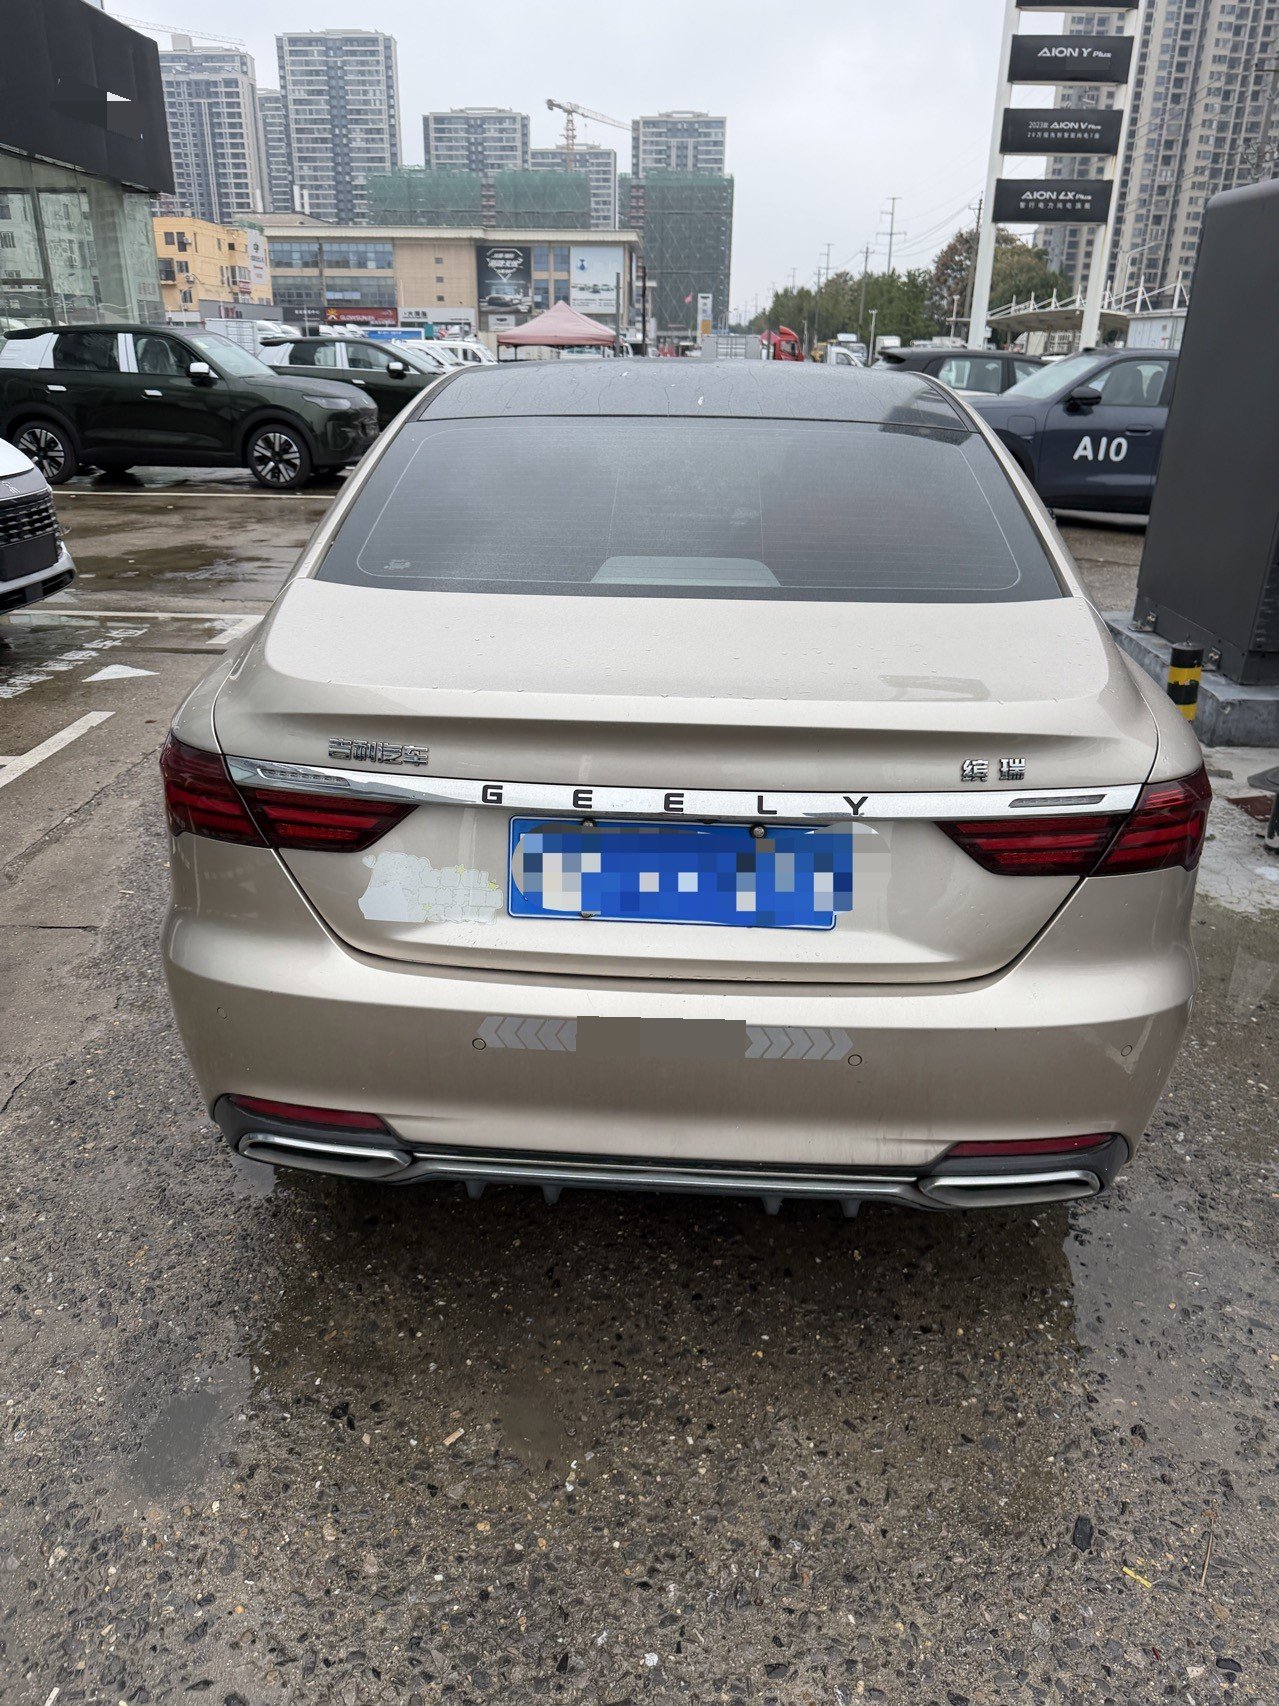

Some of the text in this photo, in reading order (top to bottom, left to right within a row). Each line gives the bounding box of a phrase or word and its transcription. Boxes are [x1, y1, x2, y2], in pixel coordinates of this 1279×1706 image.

[1037, 47, 1112, 58] AION Y Plus
[1050, 121, 1079, 130] AION
[1021, 190, 1057, 200] AION
[1058, 191, 1076, 200] LX
[328, 737, 429, 766] 吉利汽车
[960, 758, 1026, 782] 缤瑞
[481, 785, 869, 816] GEELY
